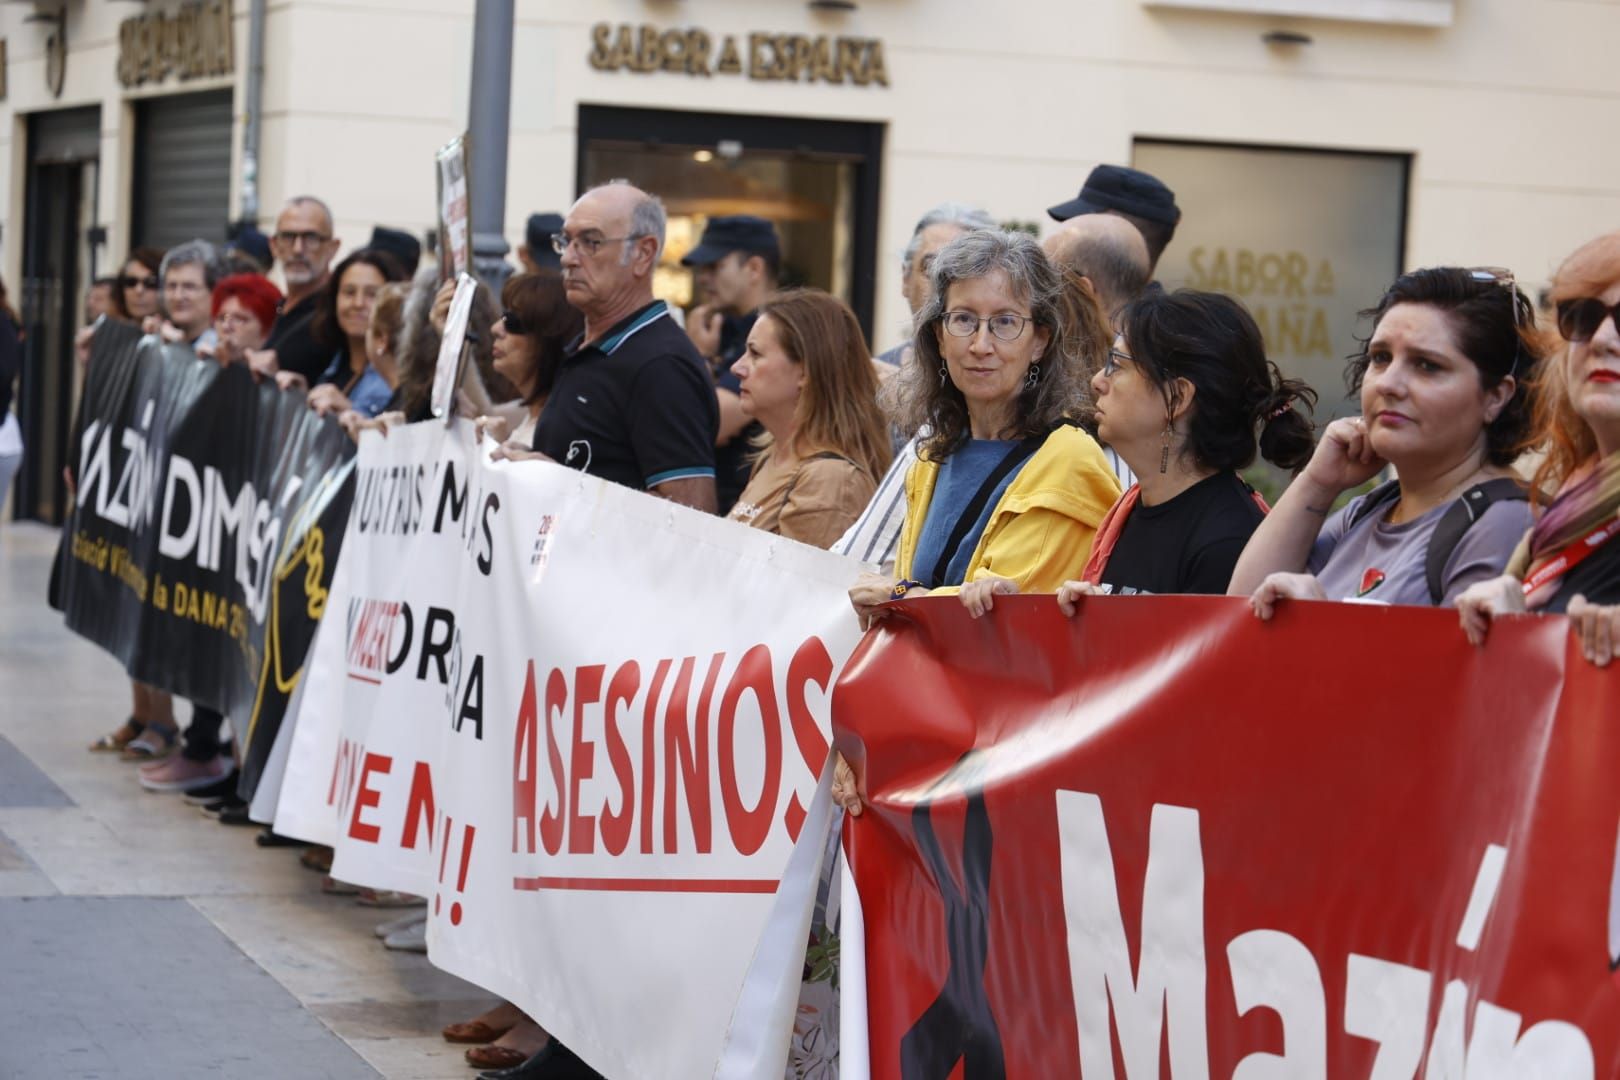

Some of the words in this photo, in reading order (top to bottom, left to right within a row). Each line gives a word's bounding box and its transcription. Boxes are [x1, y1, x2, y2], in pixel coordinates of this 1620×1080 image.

[589, 22, 711, 77] SABOR
[718, 36, 742, 74] A
[1185, 247, 1309, 298] SABOR
[1312, 259, 1335, 296] A
[173, 582, 228, 630] DANA
[511, 635, 834, 857] ASESINOS
